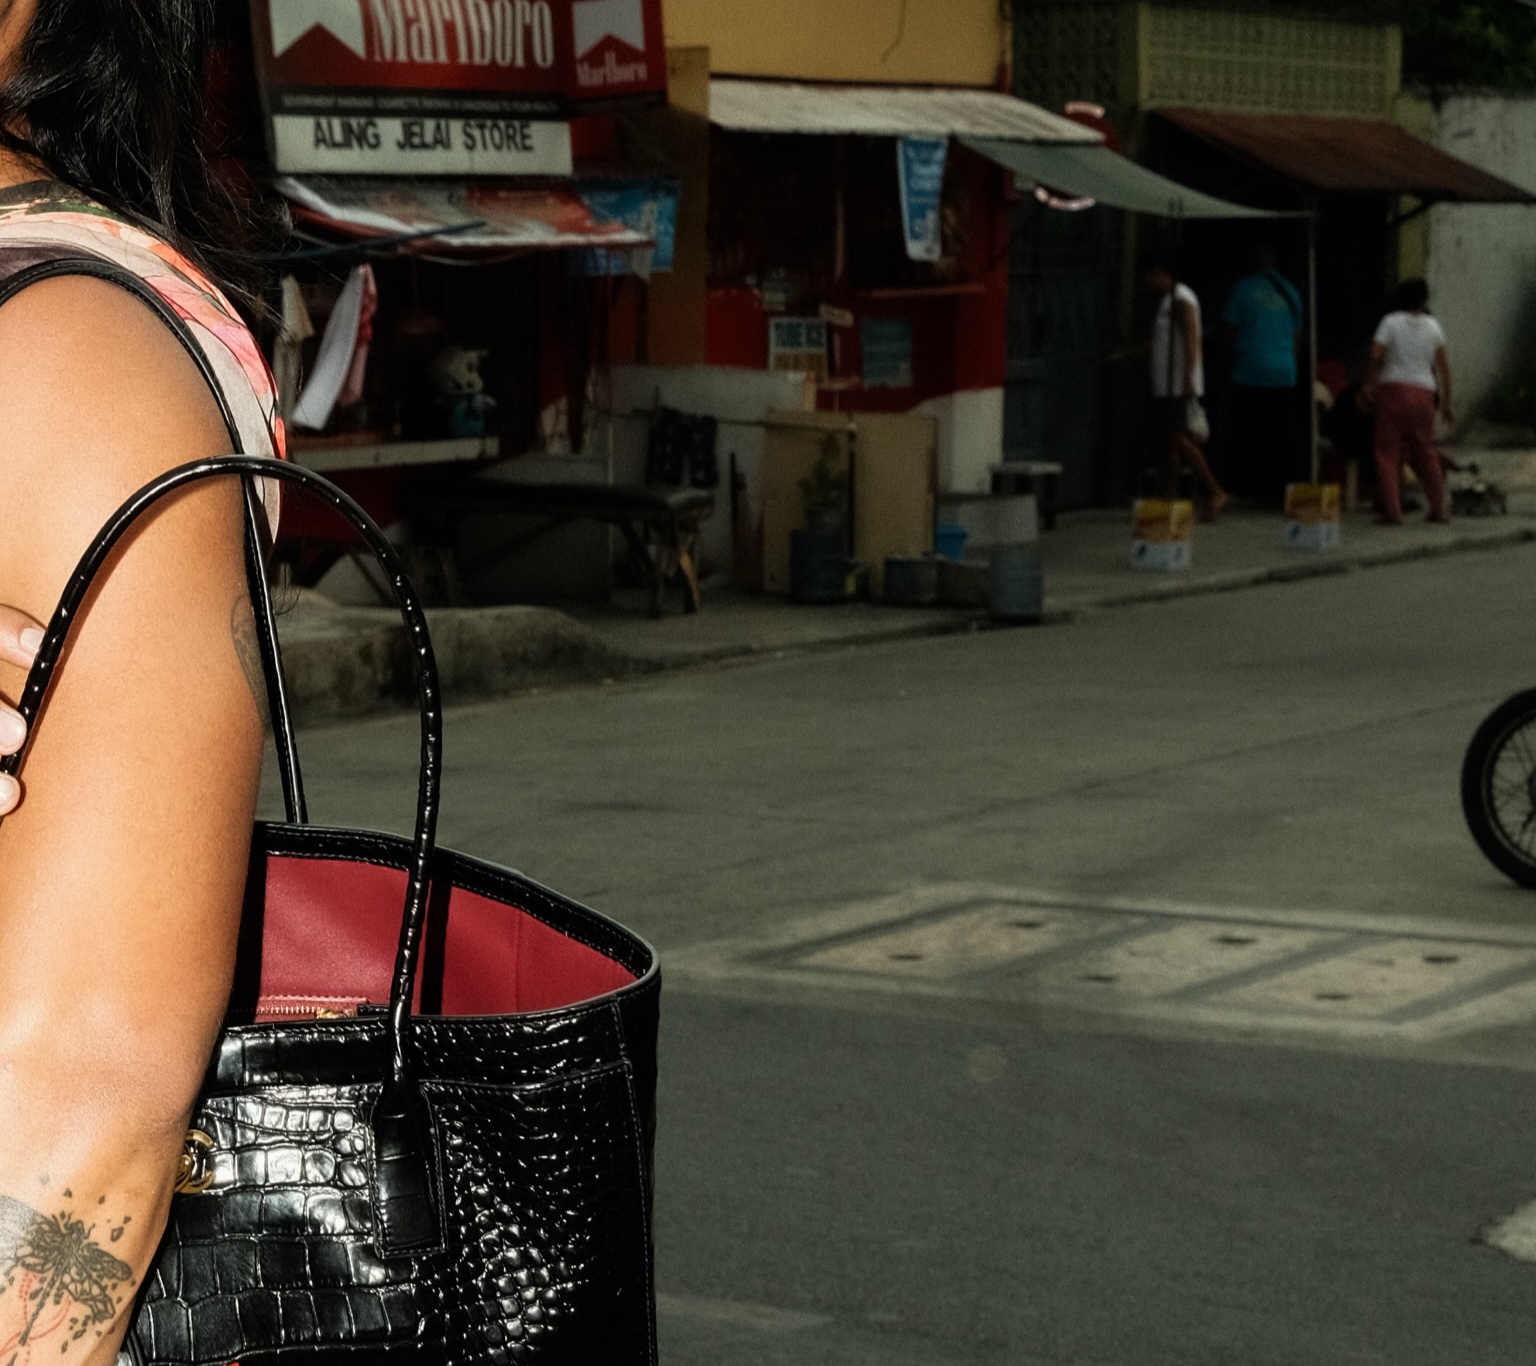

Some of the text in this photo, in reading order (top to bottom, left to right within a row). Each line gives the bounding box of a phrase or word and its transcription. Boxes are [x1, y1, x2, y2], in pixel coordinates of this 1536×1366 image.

[576, 50, 648, 88] Marlboro
[314, 117, 533, 151] ALING JELAI STORE
